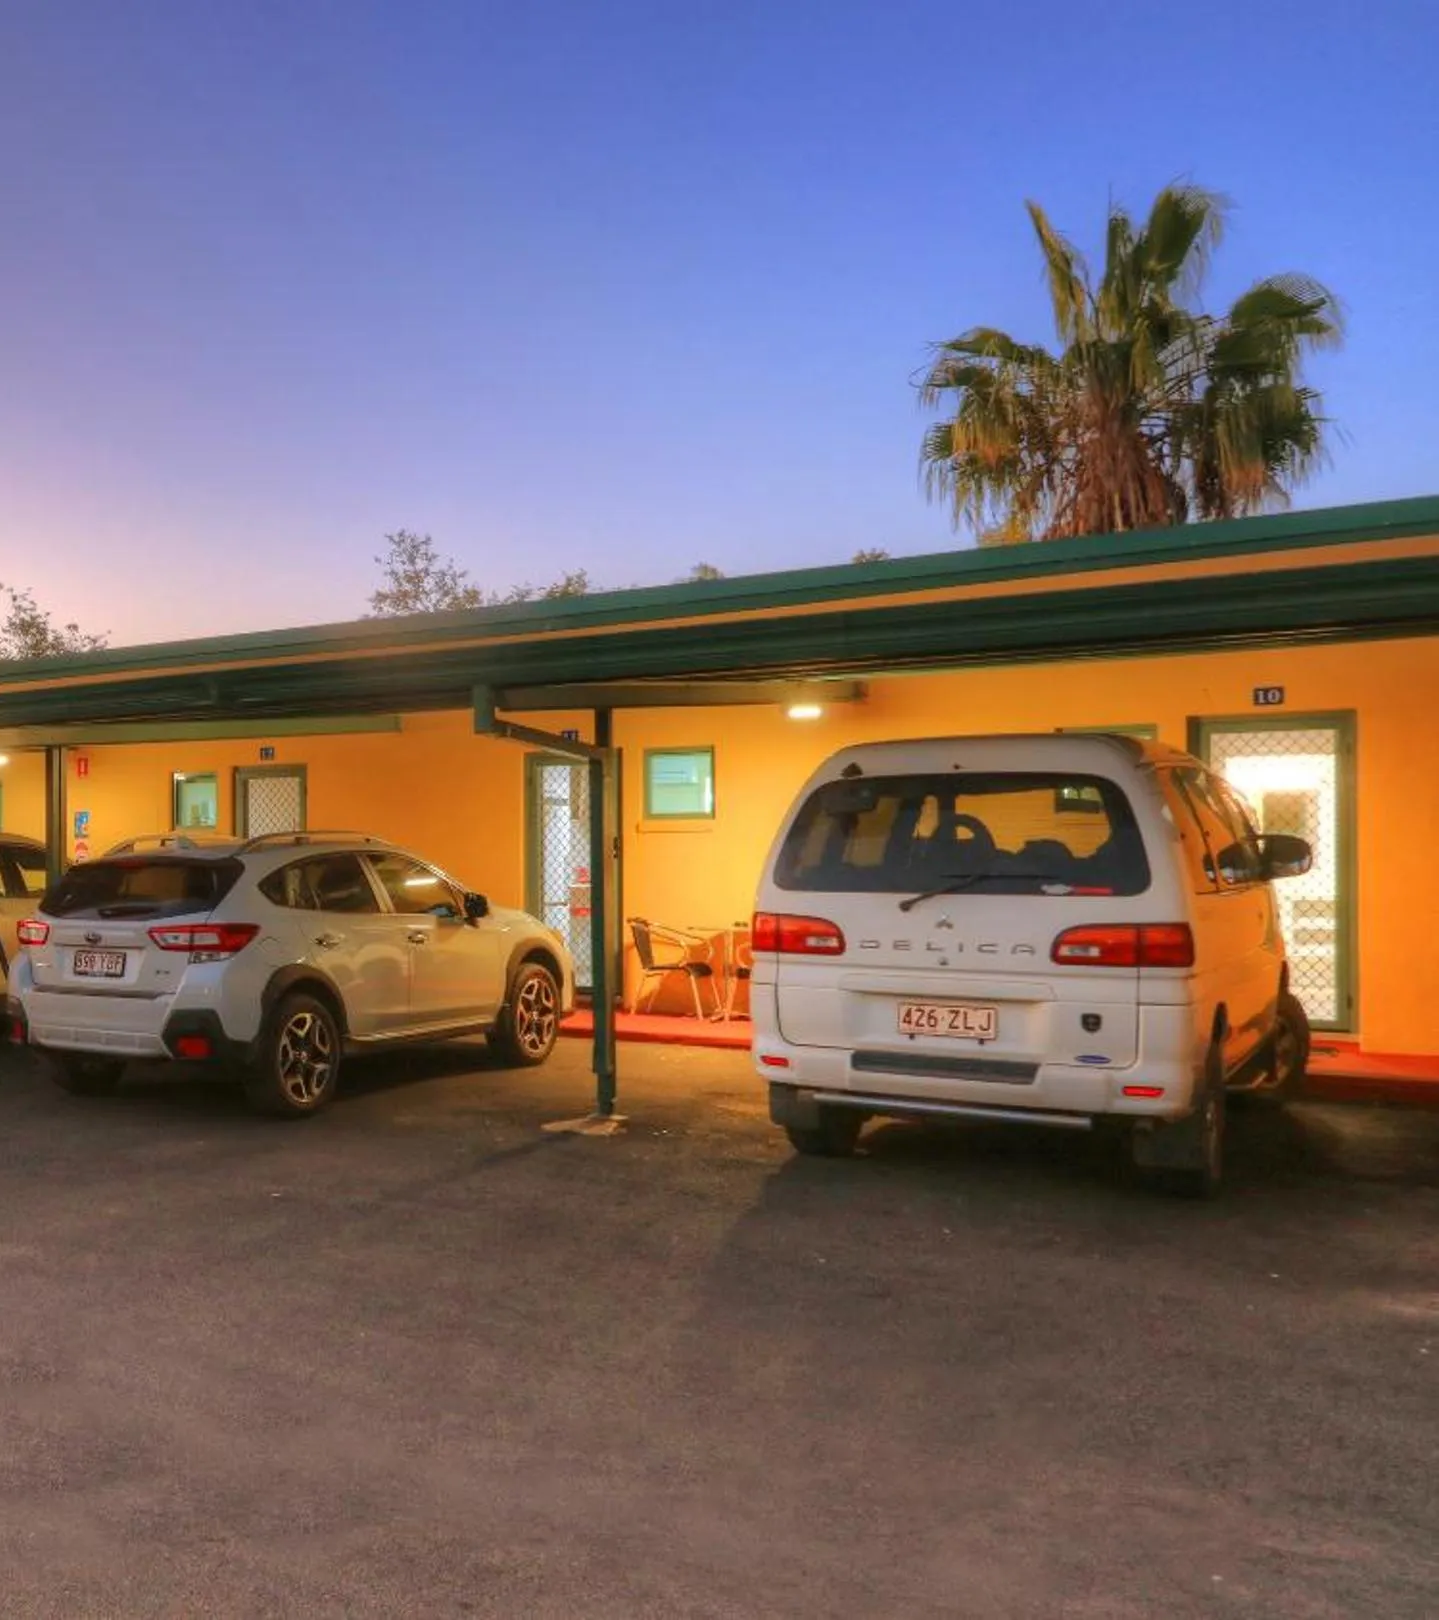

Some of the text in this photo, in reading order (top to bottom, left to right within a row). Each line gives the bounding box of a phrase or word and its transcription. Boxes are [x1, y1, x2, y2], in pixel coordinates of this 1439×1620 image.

[1256, 689, 1281, 704] 10
[859, 939, 1036, 955] DELICA
[902, 1007, 991, 1032] 426 ZLJ
